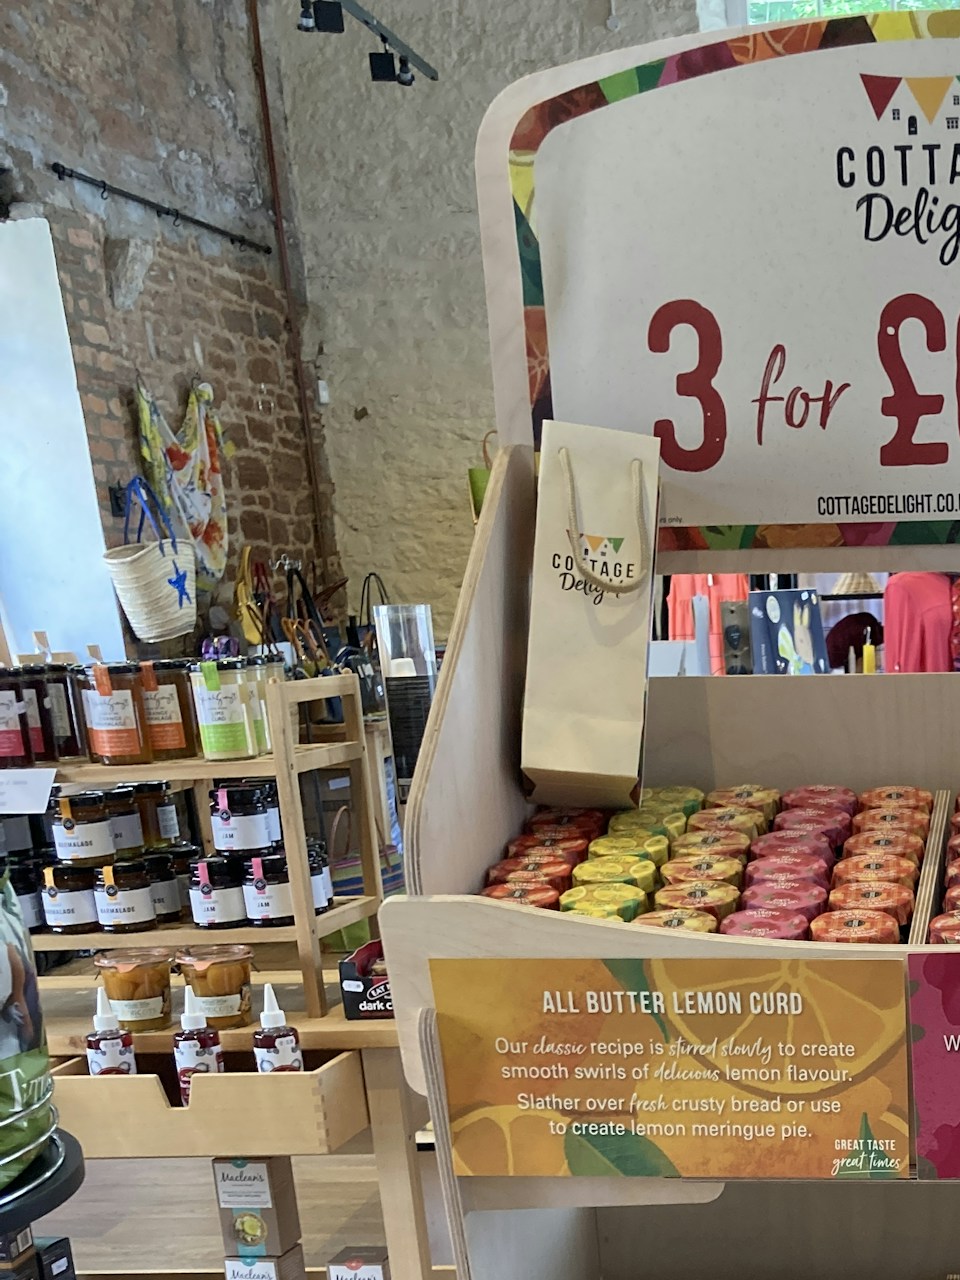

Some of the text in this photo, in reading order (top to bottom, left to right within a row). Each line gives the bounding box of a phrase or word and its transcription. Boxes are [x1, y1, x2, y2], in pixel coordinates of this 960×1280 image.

[648, 299, 727, 472] 3
[751, 344, 851, 446] for
[553, 554, 635, 578] COTAGE
[359, 1001, 384, 1010] dark
[543, 991, 802, 1014] ALL BUTTER LEMON CURD
[495, 1036, 854, 1064] Our classic recipe is stirred slowly to create
[501, 1063, 853, 1082] smooth swirls of delicious lemon flavour.
[221, 1171, 265, 1183] Maclean's
